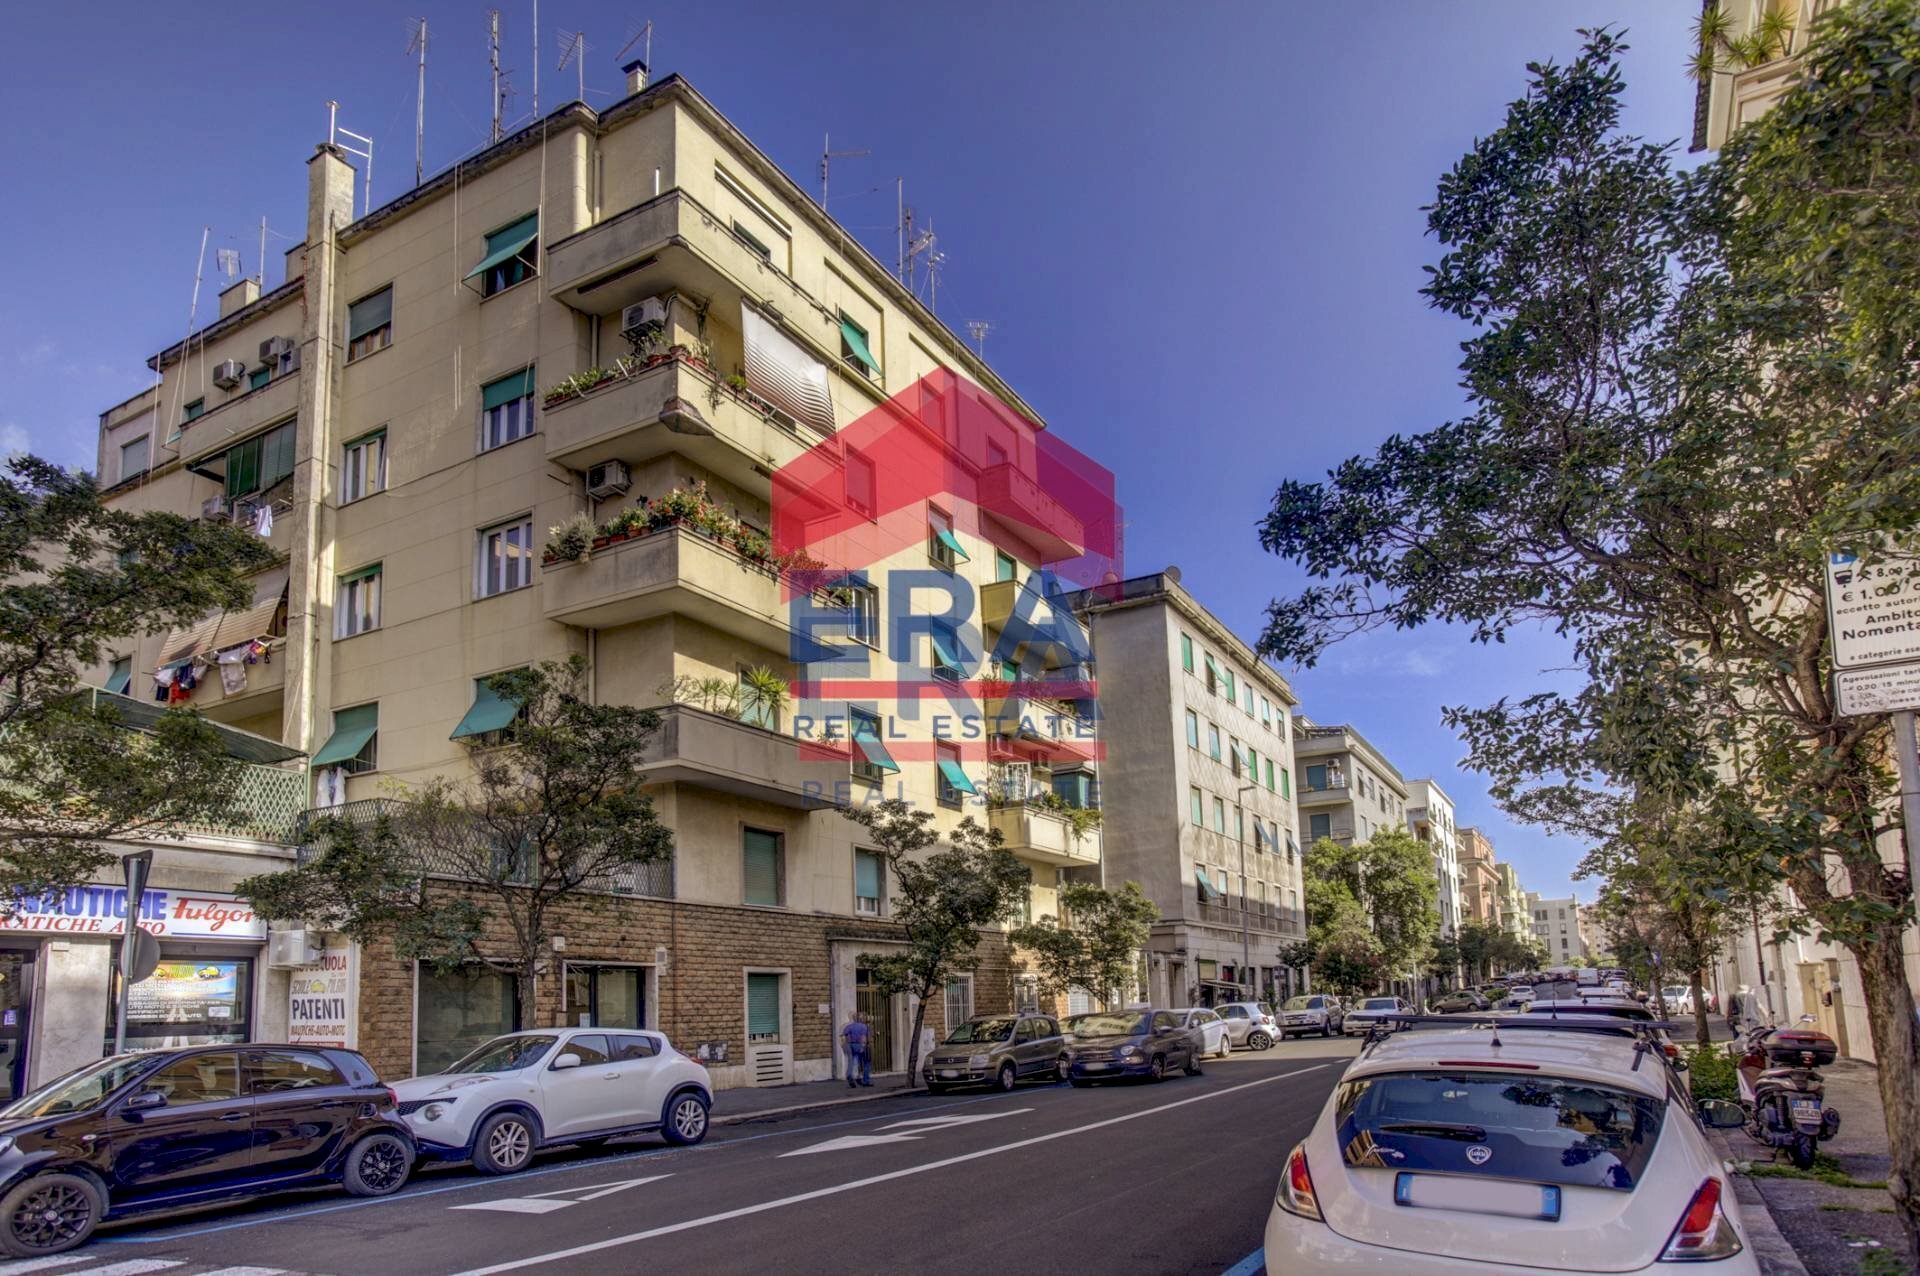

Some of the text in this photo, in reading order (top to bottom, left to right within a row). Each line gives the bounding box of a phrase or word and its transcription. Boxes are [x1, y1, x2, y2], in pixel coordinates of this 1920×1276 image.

[1836, 603, 1881, 615] eccetto
[1858, 648, 1902, 660] categorie
[172, 897, 253, 931] Fulgor
[109, 920, 166, 934] ATO
[292, 998, 345, 1020] PATENTI
